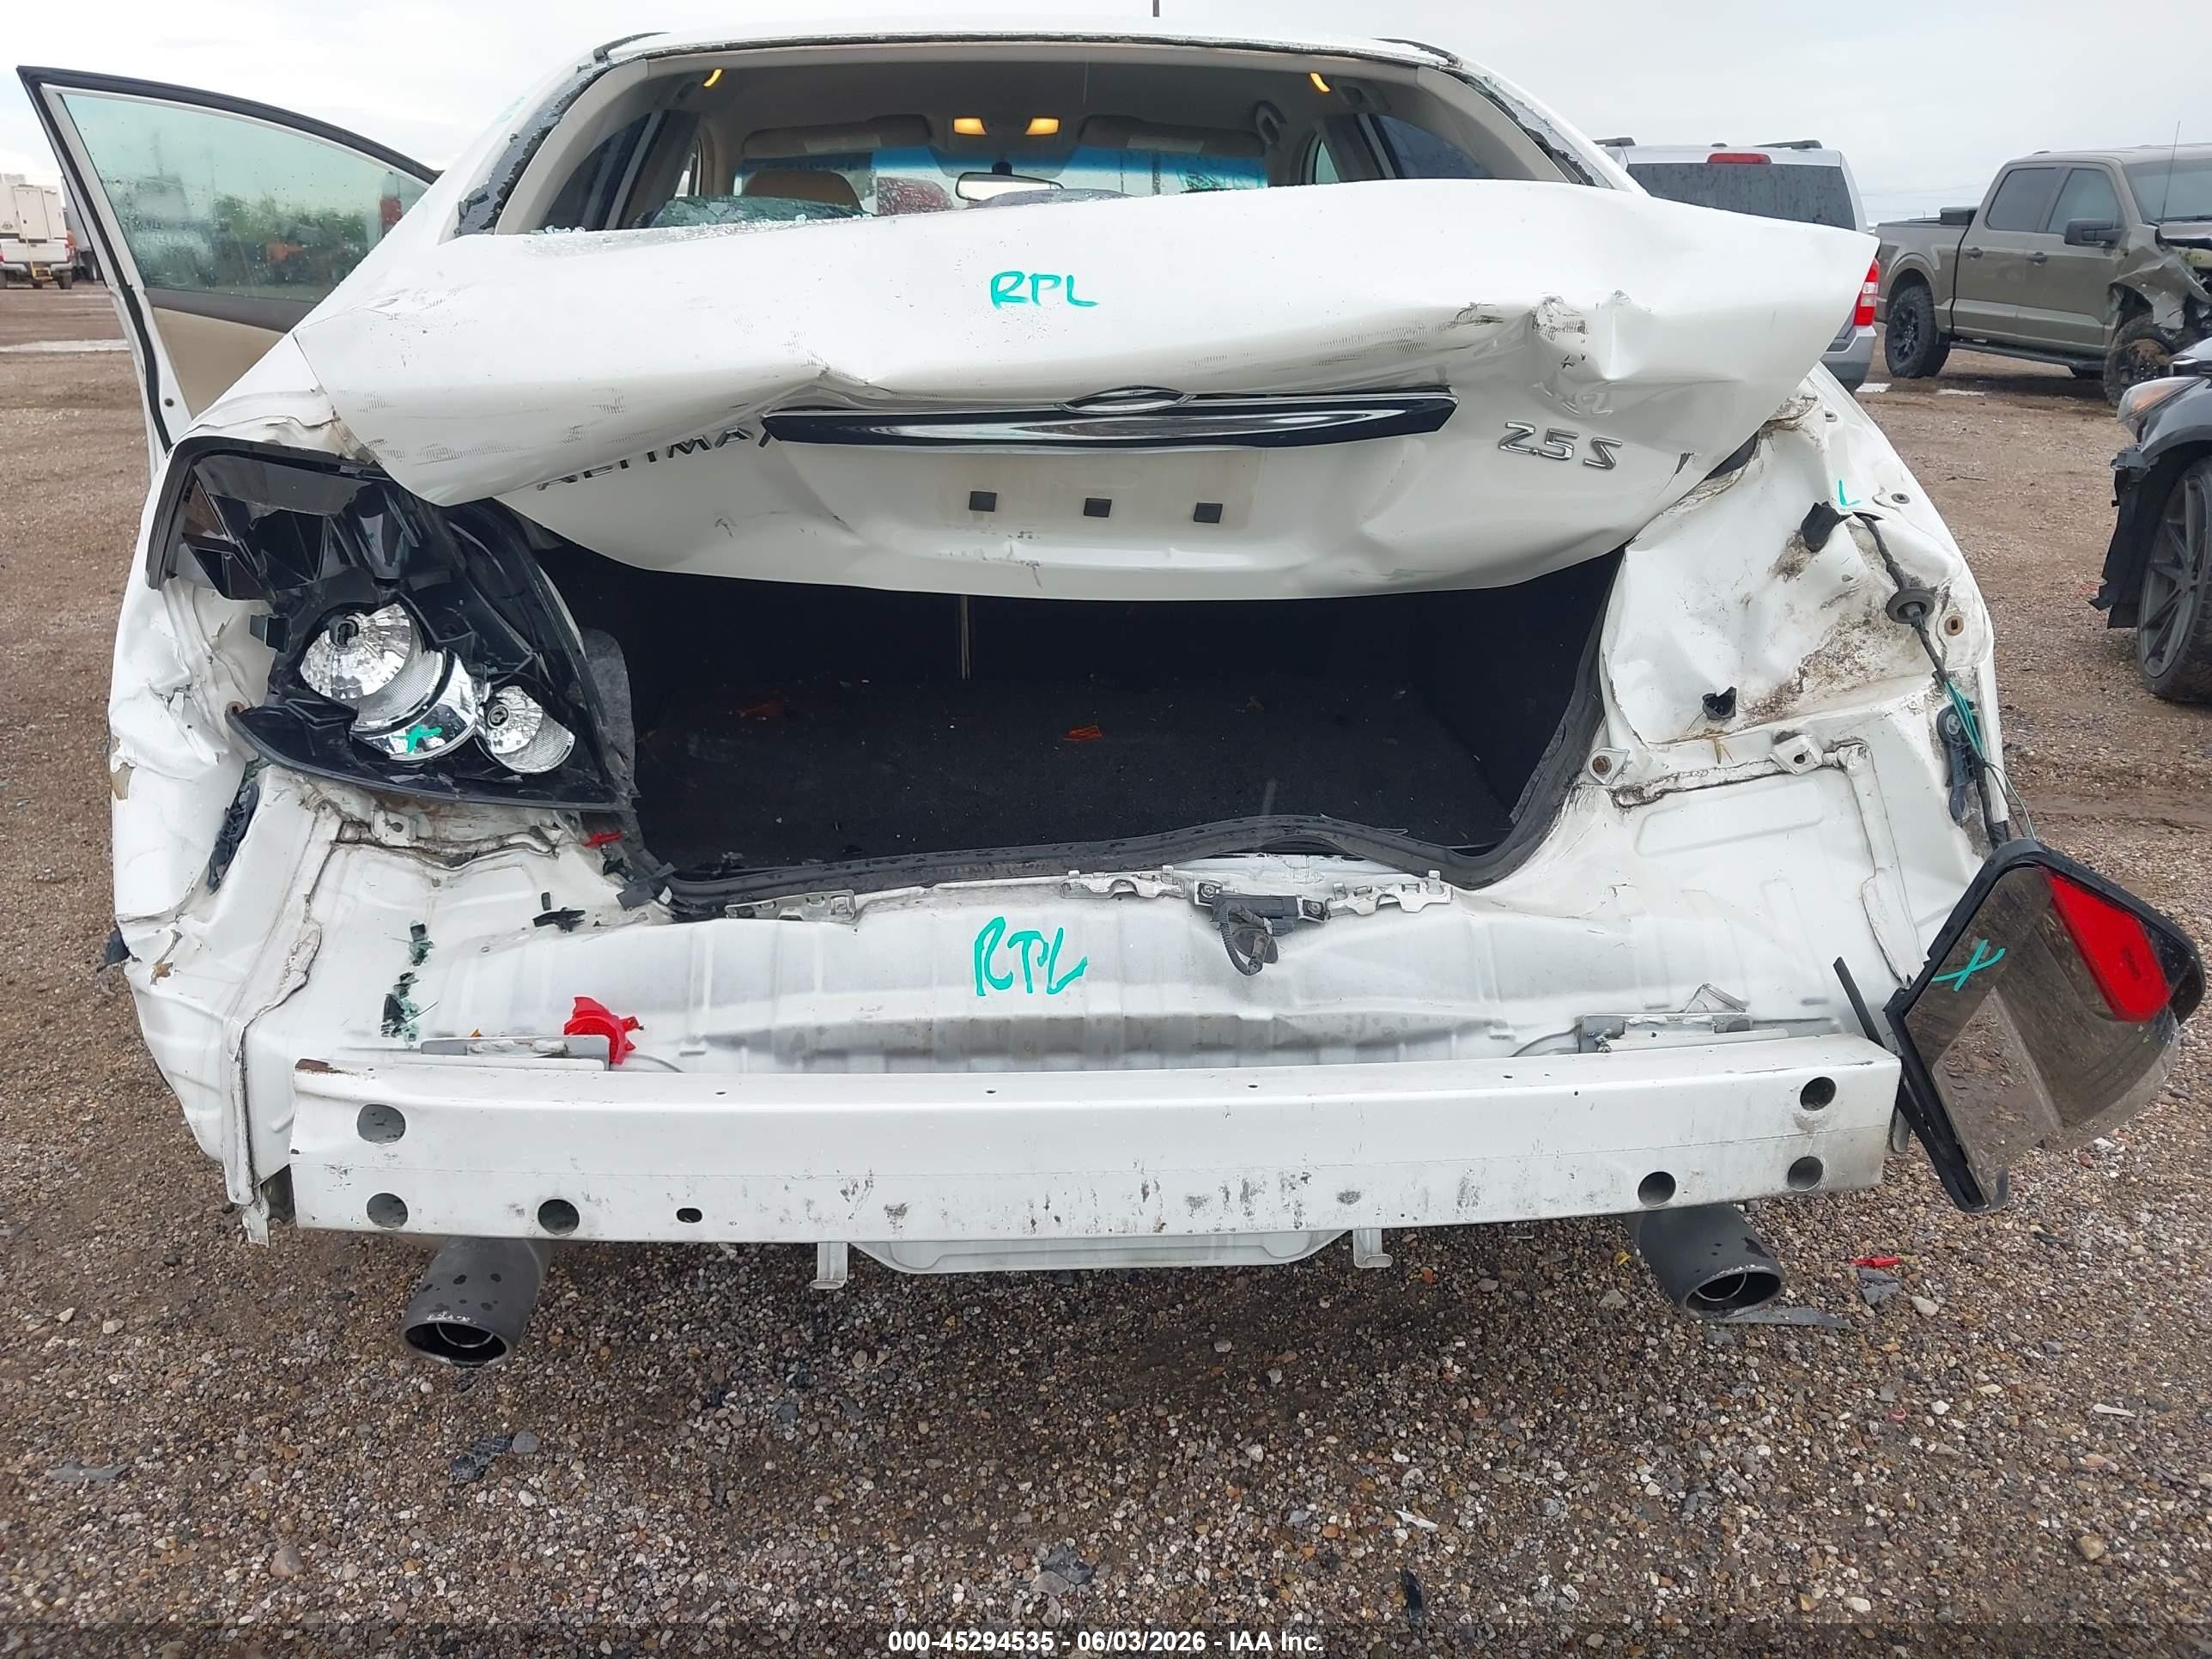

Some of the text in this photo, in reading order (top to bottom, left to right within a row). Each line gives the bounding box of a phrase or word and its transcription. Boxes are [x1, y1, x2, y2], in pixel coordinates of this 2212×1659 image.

[990, 270, 1099, 310] RPL
[1497, 421, 1624, 471] 2.5 S
